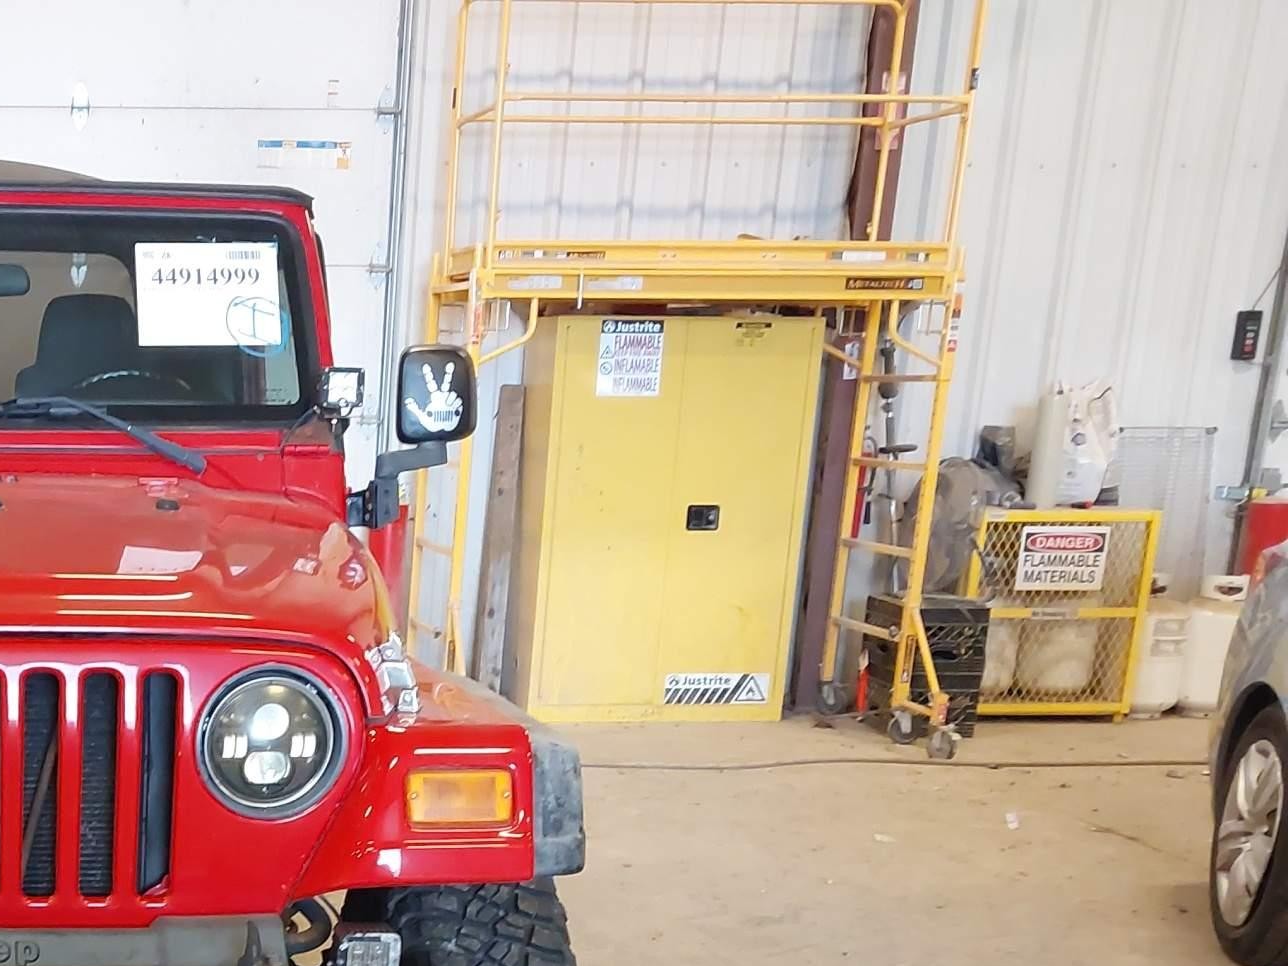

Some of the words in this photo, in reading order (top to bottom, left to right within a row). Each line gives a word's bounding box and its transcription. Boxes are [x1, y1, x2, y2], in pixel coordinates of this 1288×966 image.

[152, 267, 260, 285] 44914999
[616, 321, 662, 332] Justrite
[615, 334, 662, 349] FLAMMABLE
[1034, 536, 1095, 549] DANGER
[1023, 553, 1101, 568] FLAMMABLE
[1022, 569, 1097, 583] MATERIALS
[682, 675, 732, 686] Justrite
